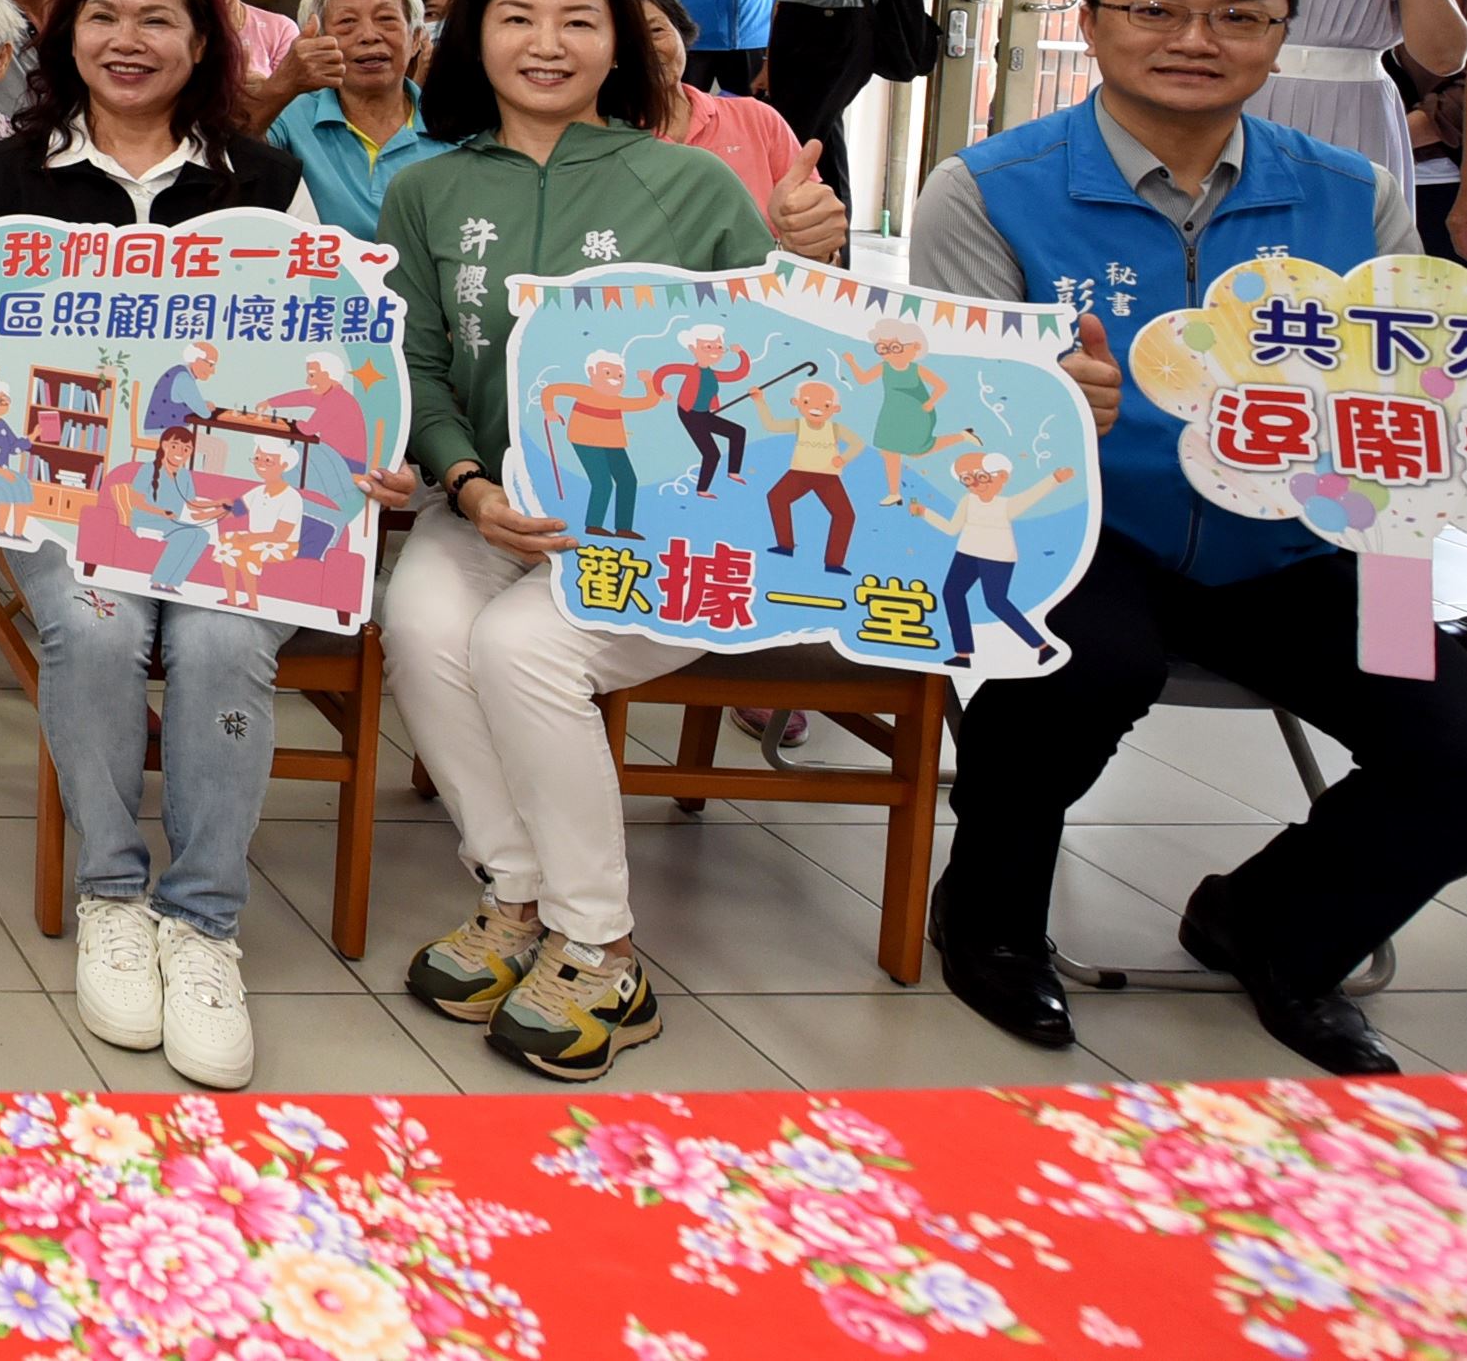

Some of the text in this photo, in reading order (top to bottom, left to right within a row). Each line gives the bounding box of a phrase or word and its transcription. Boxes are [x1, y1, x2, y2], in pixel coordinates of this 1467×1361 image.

[580, 229, 621, 262] 縣
[1105, 262, 1137, 317] 秘書
[1216, 389, 1467, 479] 逗鬧
[576, 538, 939, 649] 歡據一堂
